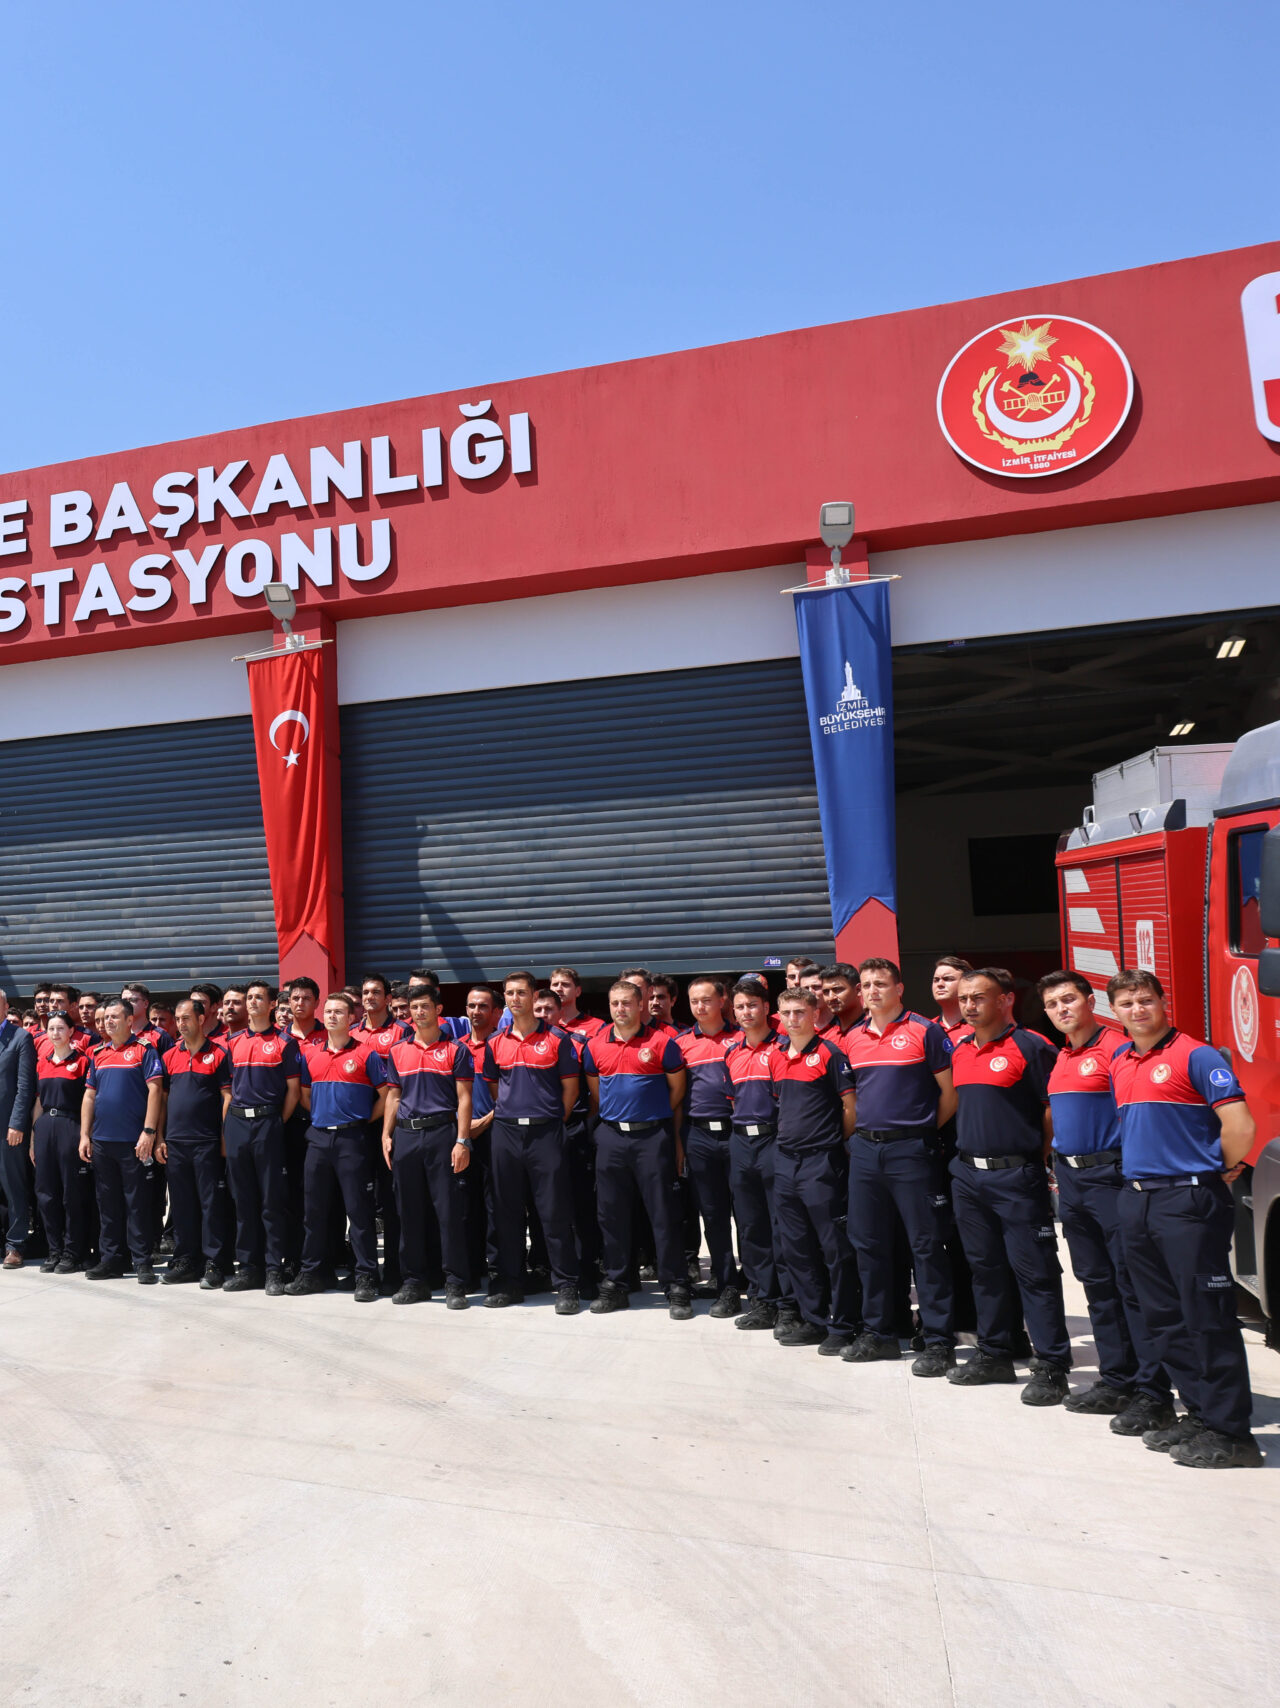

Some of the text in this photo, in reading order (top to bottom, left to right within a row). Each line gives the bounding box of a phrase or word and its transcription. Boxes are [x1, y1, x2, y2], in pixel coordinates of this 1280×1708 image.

[1002, 448, 1077, 467] İZMİR İTFAİYESİ
[49, 399, 532, 538] BAŞKANLIĞI
[836, 699, 869, 712] İZMİR
[820, 706, 886, 726] BÜYÜKŞEHİR
[823, 717, 886, 735] BELEDİYESİ
[1139, 929, 1152, 965] 112
